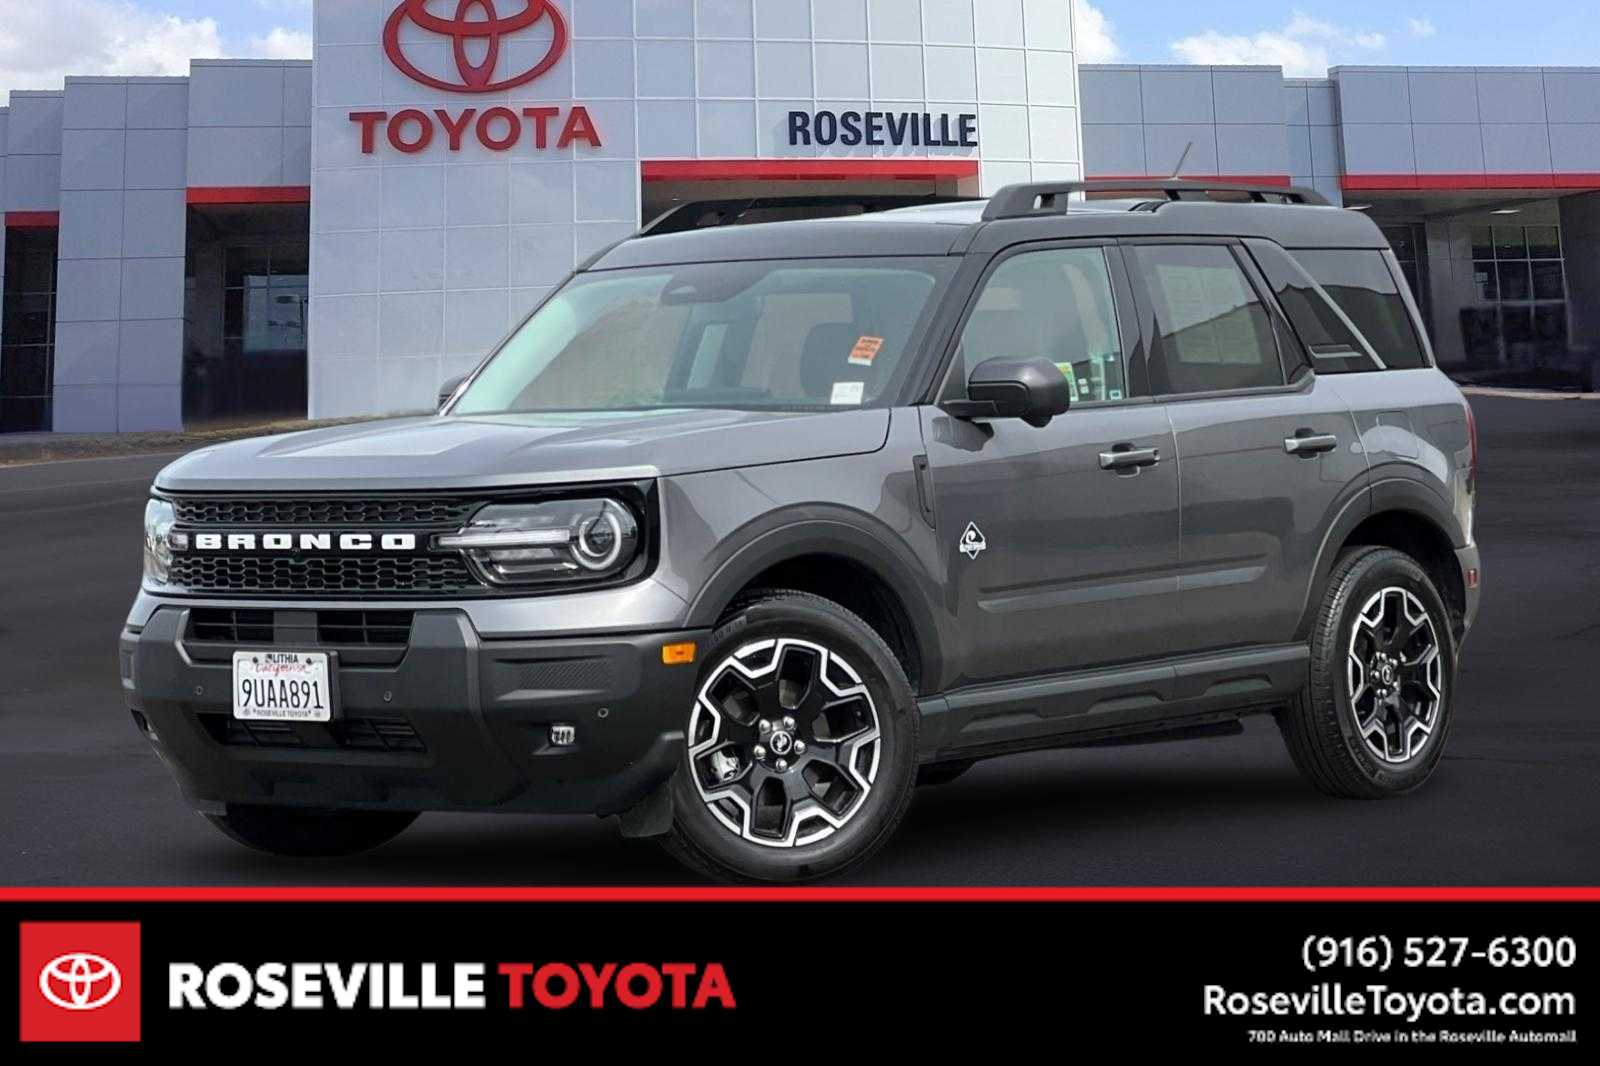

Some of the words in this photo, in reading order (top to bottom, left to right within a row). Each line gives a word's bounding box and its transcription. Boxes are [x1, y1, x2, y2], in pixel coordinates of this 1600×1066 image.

[349, 106, 602, 154] TOYOTA
[788, 110, 978, 147] ROSEVILLE
[195, 533, 416, 550] BRONCO
[272, 653, 299, 663] LITHIA
[242, 679, 324, 709] 9UAA891
